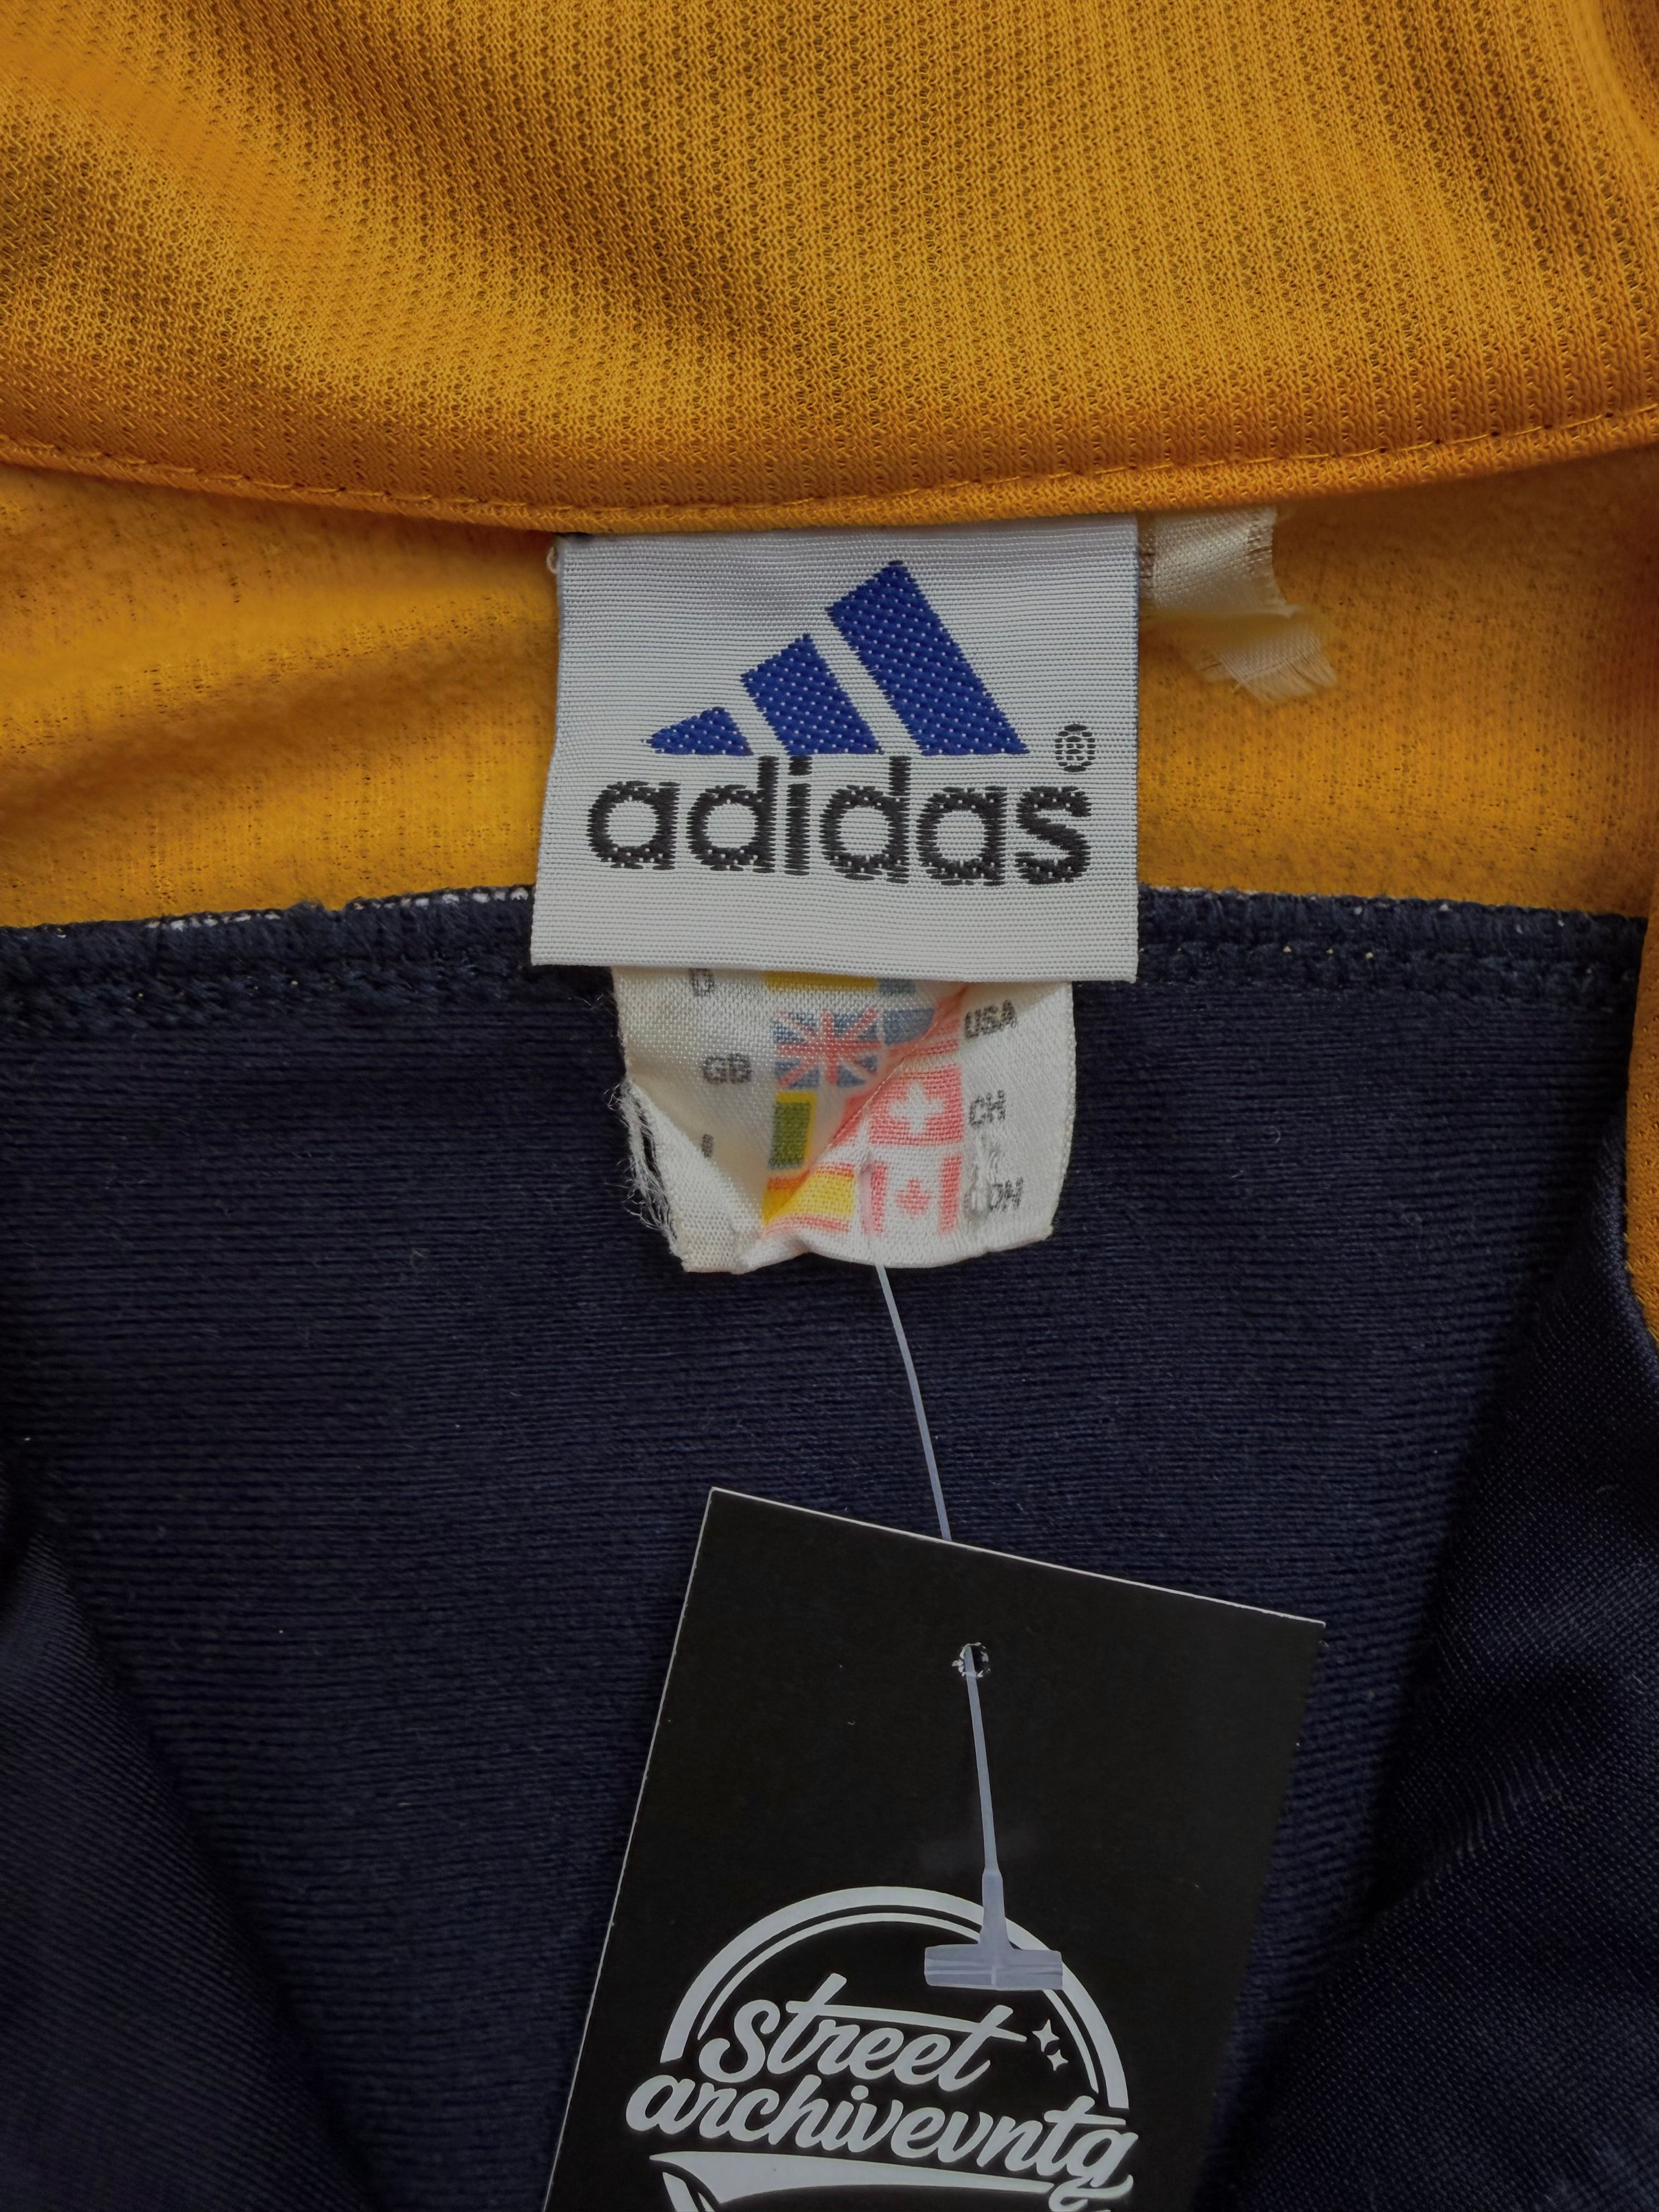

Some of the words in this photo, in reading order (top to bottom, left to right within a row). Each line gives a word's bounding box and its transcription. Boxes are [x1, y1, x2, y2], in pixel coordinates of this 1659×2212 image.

[587, 756, 1092, 886] adidas
[964, 999, 1017, 1038] USA
[702, 1053, 752, 1085] GB
[969, 1090, 1006, 1128] CH
[625, 2074, 1139, 2212] archivevntg
